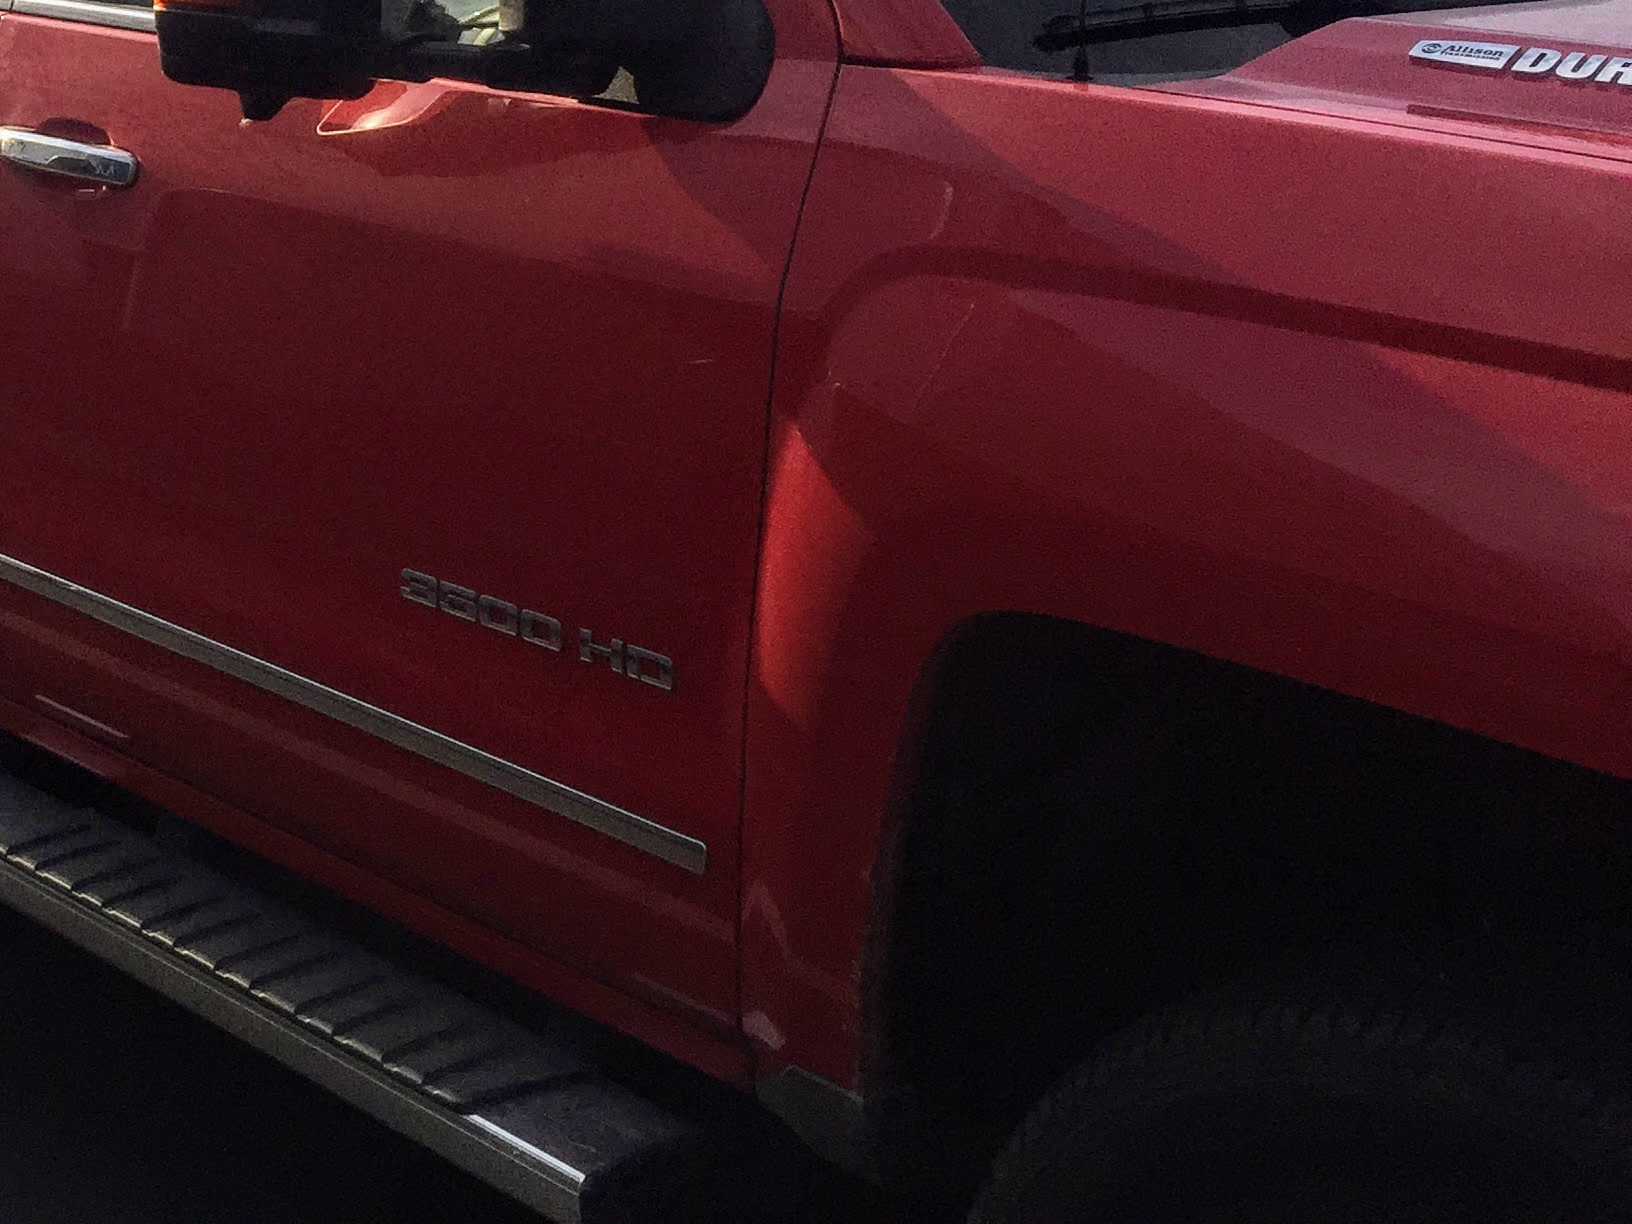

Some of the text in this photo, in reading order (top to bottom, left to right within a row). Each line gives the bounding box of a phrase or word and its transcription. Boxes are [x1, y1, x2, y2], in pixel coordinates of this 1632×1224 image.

[1442, 44, 1504, 58] Allison
[400, 567, 673, 691] 3500 HD
